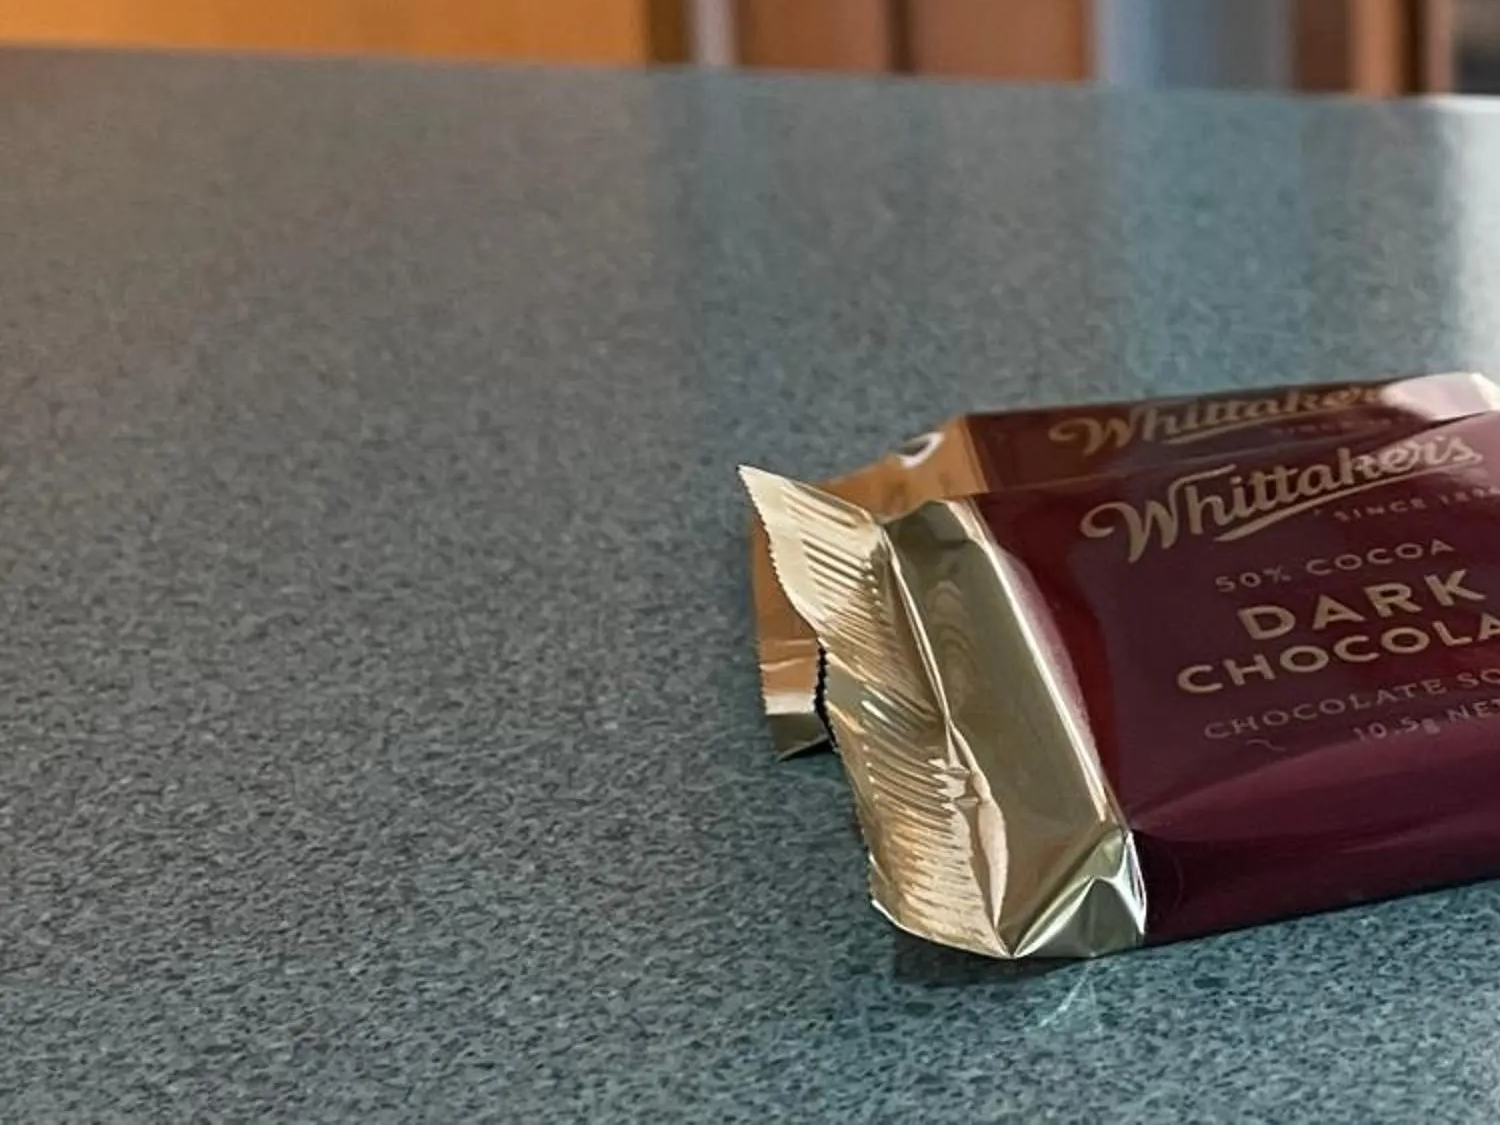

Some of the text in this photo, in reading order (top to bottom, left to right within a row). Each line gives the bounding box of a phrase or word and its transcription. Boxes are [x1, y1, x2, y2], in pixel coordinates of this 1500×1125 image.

[1080, 434, 1484, 554] Whittaker's
[1333, 496, 1428, 522] SINCE
[1214, 538, 1456, 593] 50% COCOA
[1237, 568, 1486, 640] DARK
[1203, 678, 1448, 740] CHOCOLATE
